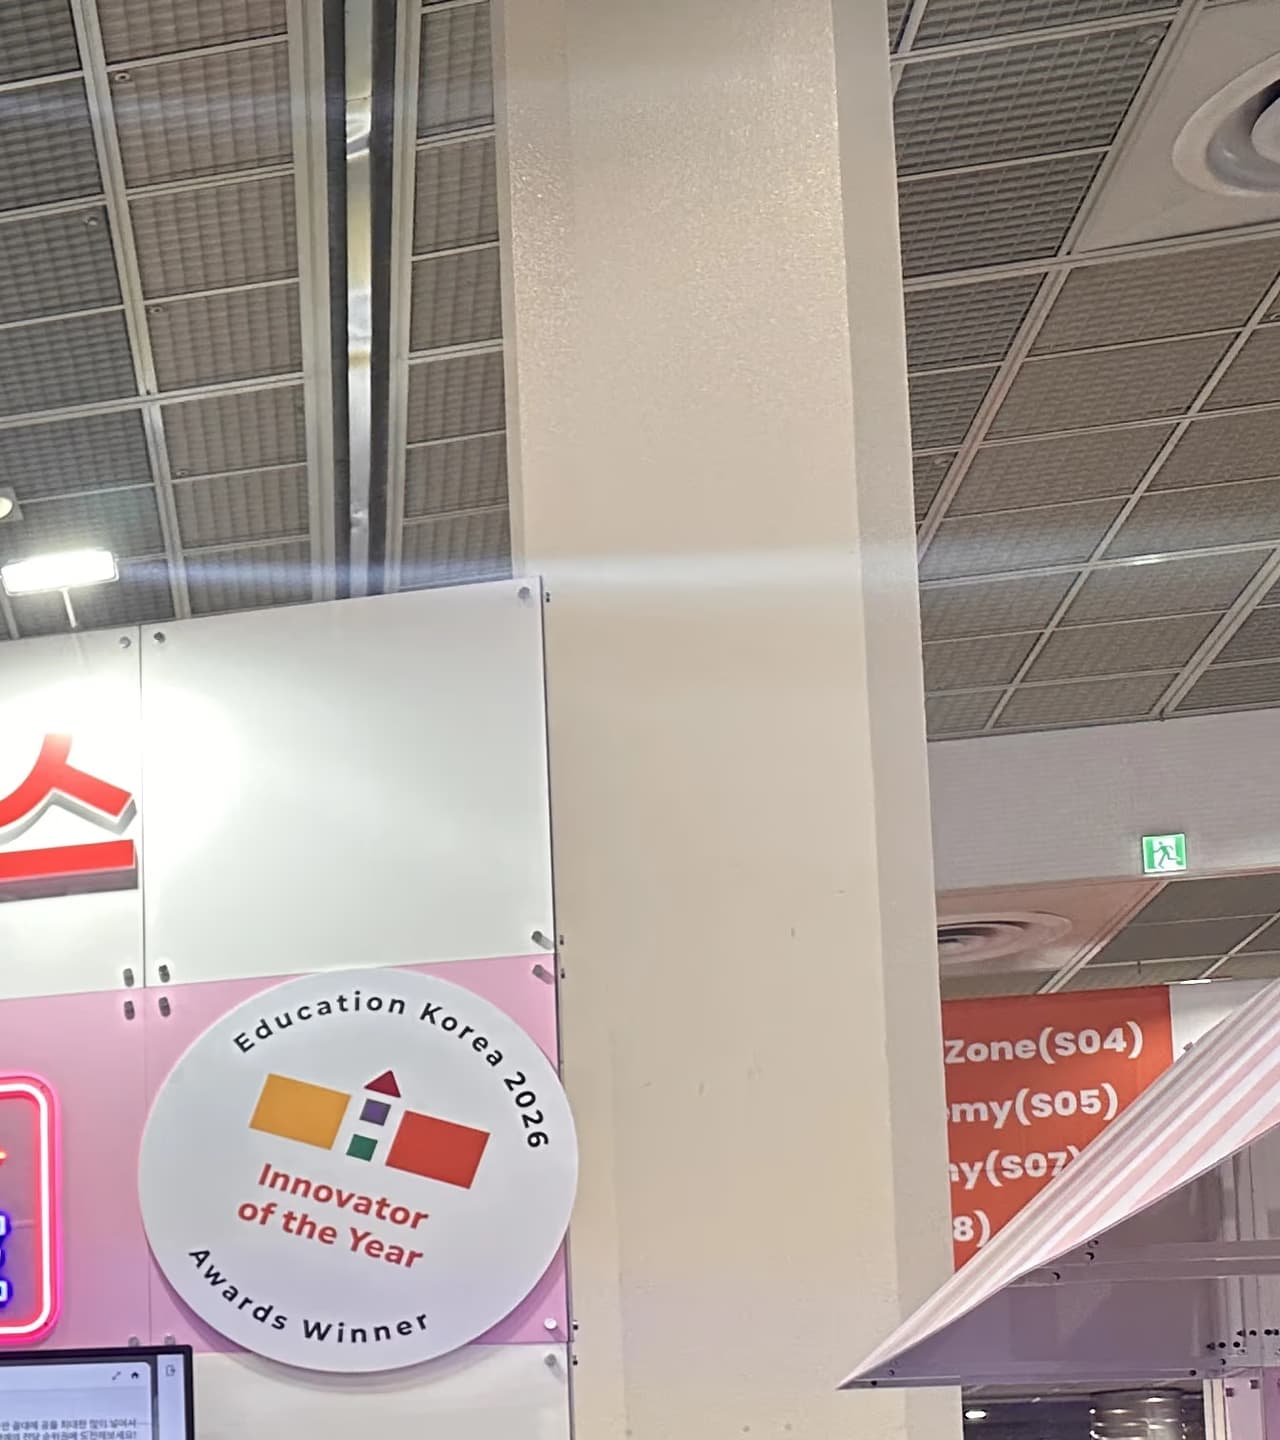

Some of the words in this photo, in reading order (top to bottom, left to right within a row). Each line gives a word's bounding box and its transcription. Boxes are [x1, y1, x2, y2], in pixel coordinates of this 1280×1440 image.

[233, 990, 406, 1053] Education
[418, 1002, 504, 1067] Korea
[503, 1071, 549, 1148] 2026
[945, 1082, 1120, 1129] my(S05)
[258, 1163, 429, 1230] Innovator
[238, 1202, 276, 1222] of
[282, 1213, 338, 1245] the
[349, 1227, 424, 1269] Year
[188, 1247, 288, 1331] Awards
[303, 1313, 428, 1344] Winner
